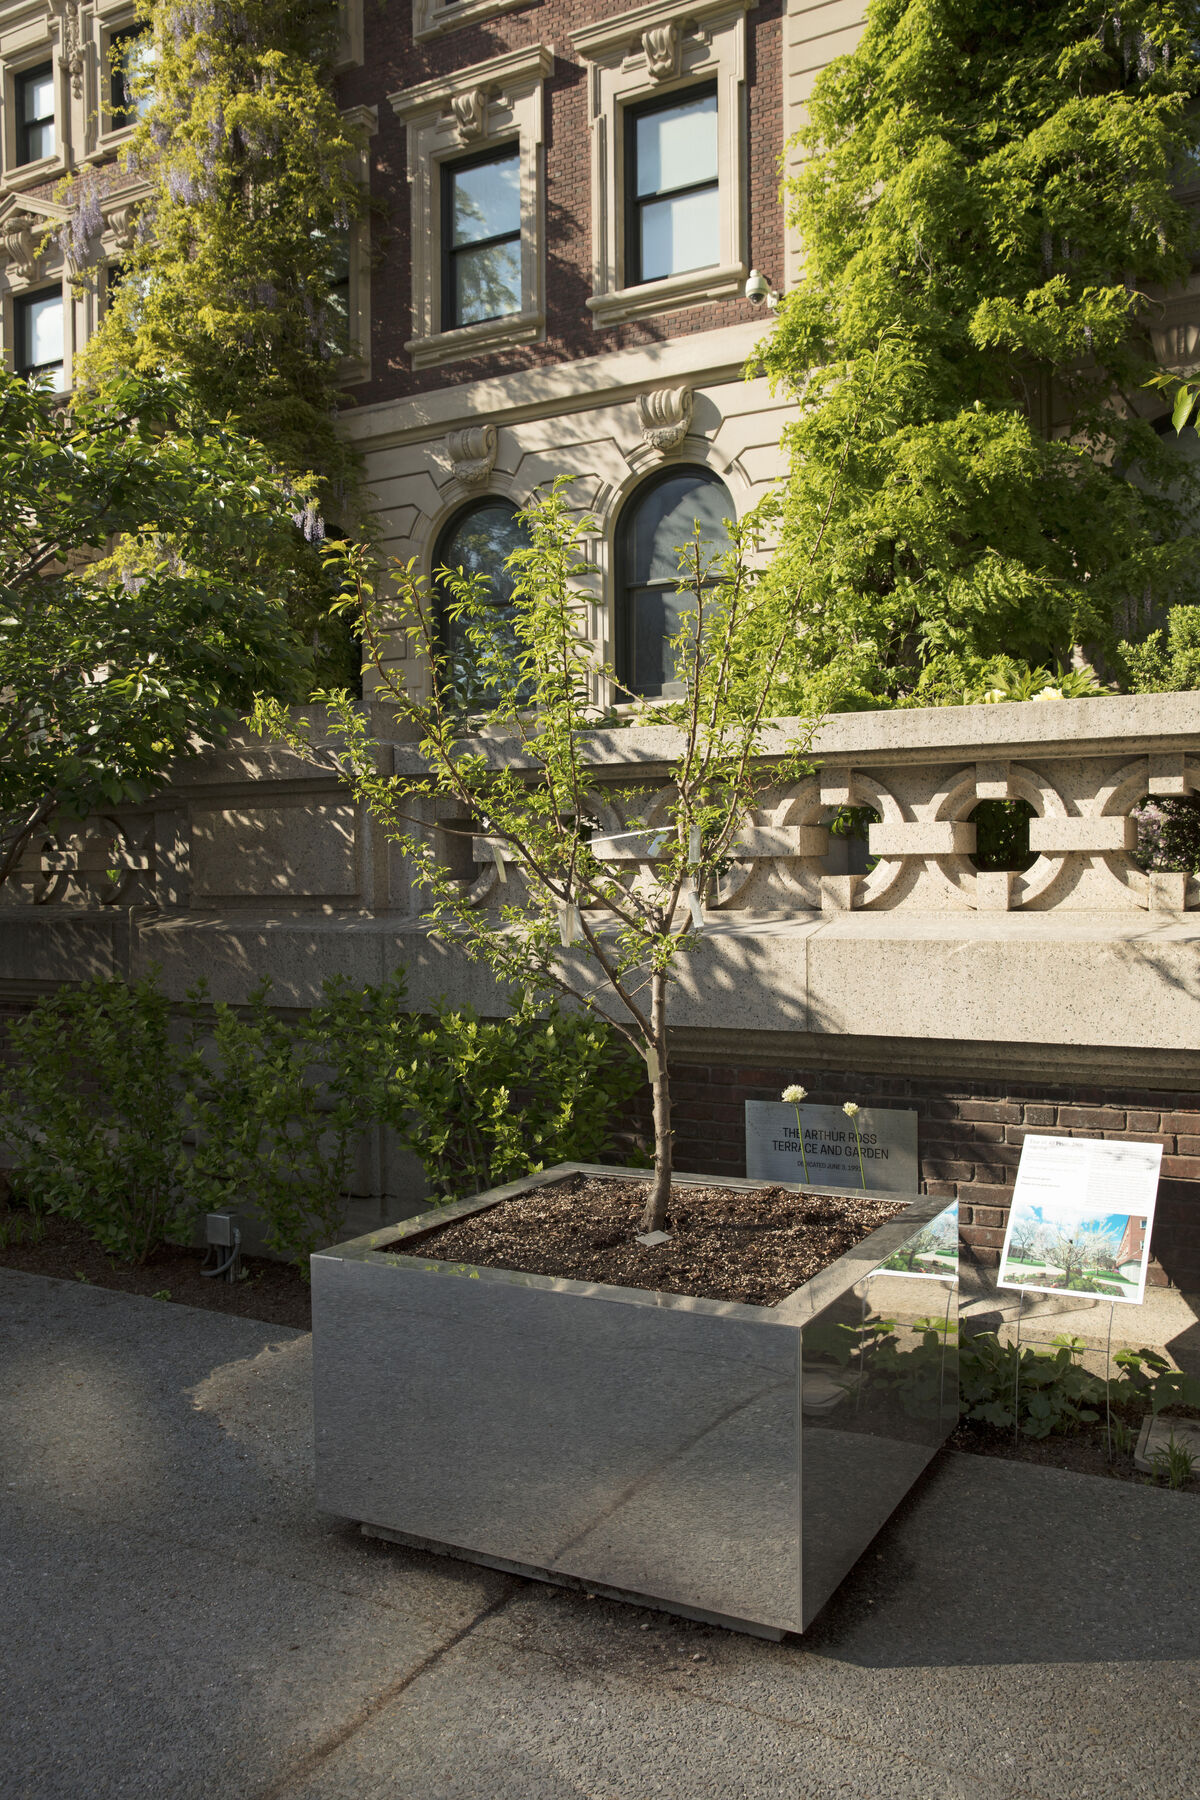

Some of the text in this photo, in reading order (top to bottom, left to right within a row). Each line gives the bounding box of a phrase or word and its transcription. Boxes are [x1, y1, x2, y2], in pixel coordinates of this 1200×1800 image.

[783, 1128, 877, 1145] THE ARTHUR ROSS
[772, 1140, 889, 1160] TERRACE AND GARDEN
[797, 1160, 826, 1169] DEICATED
